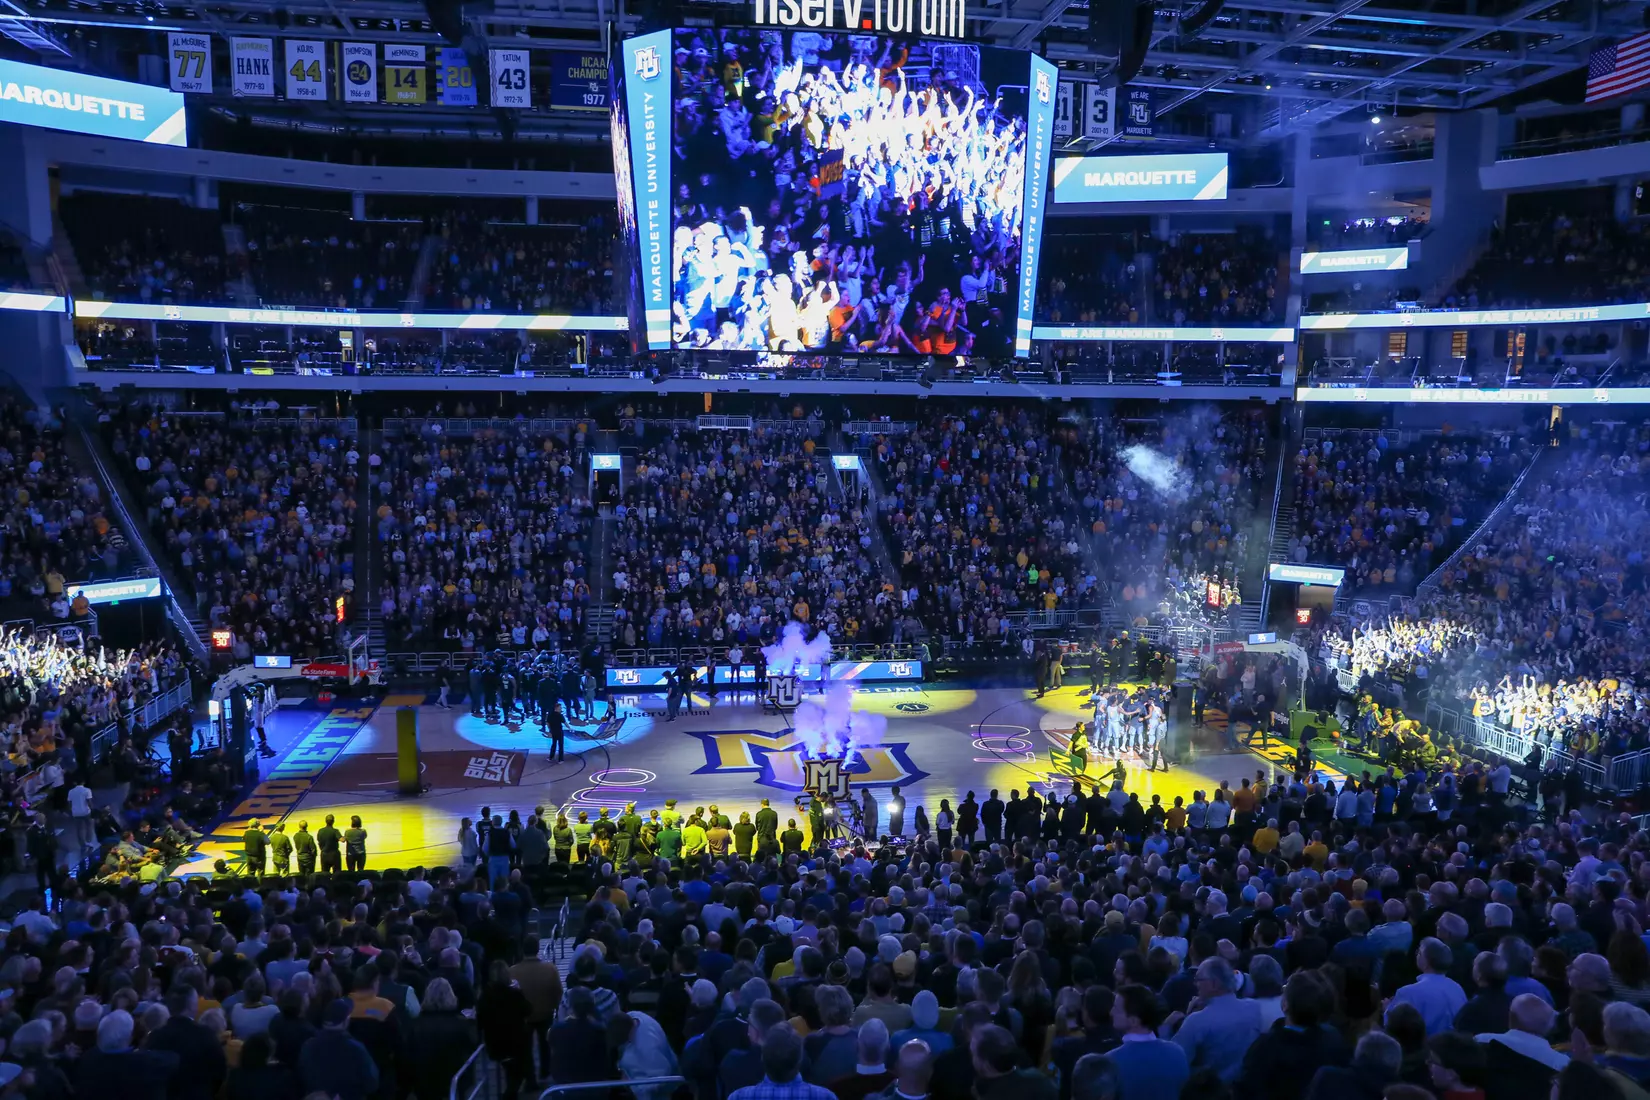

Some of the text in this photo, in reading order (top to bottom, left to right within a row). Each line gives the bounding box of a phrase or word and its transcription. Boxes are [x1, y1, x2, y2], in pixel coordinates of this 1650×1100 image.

[172, 38, 180, 47] AL
[345, 47, 372, 56] THOMPSON
[391, 49, 419, 58] MEMINGER
[502, 54, 521, 62] TATUM
[581, 56, 606, 68] NCAA
[174, 50, 206, 78] 77
[237, 57, 270, 75] HANK
[290, 59, 322, 82] 44
[350, 63, 368, 81] 24
[634, 45, 662, 81] MU
[394, 68, 418, 88] 14
[446, 66, 472, 87] 20
[498, 68, 526, 90] 43
[568, 67, 608, 80] CHAMPIO
[582, 93, 605, 105] 1977
[1141, 92, 1150, 100] ARE
[1093, 100, 1109, 124] 3
[1126, 126, 1152, 135] MARQUETTE
[1084, 169, 1197, 187] MARQUETTE
[643, 91, 663, 302] MARQUETTE UNIVERSITY
[1022, 112, 1045, 312] MARQUETTE UNIVERSITY
[1320, 255, 1386, 267] MARQUETTE
[1511, 308, 1600, 322] MARQUETTE
[62, 629, 77, 637] FOX
[615, 669, 641, 685] MU
[888, 662, 912, 678] MU
[767, 675, 803, 709] MU
[463, 756, 489, 779] BIG
[483, 751, 508, 782] EAST
[802, 758, 850, 801] MU
